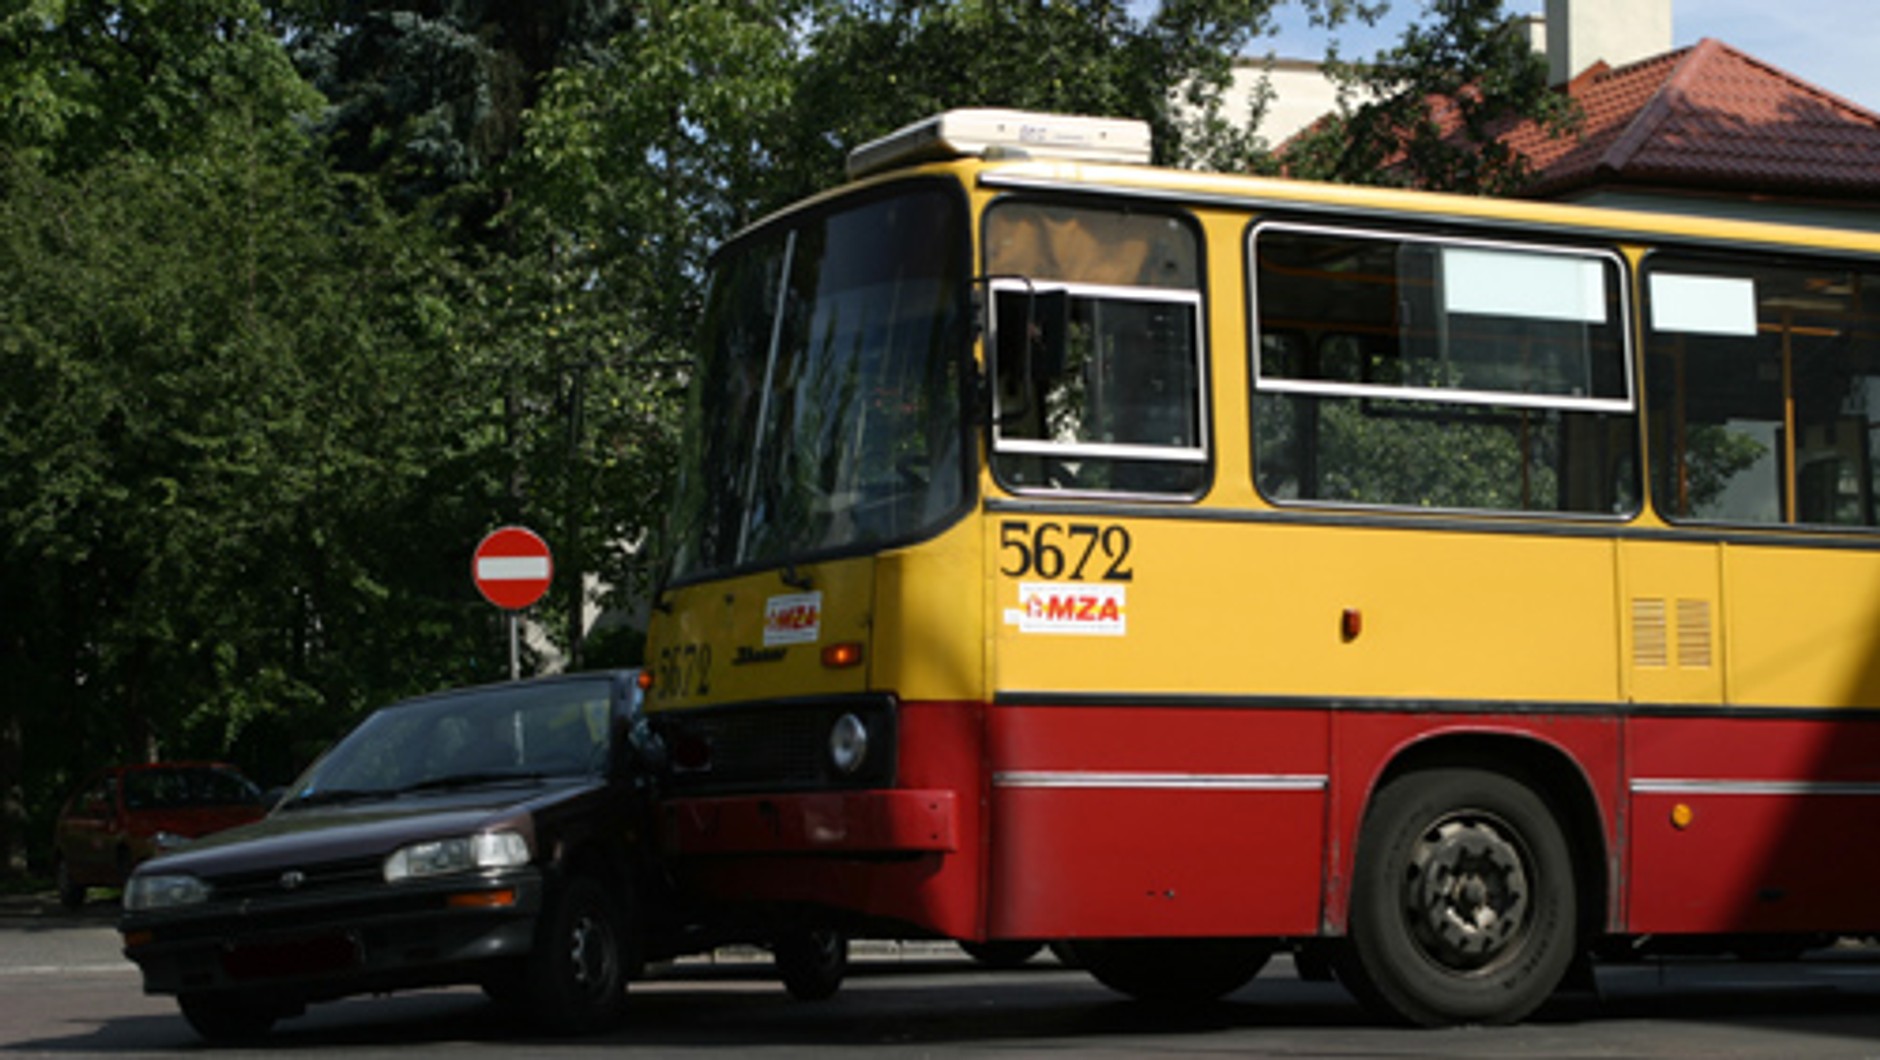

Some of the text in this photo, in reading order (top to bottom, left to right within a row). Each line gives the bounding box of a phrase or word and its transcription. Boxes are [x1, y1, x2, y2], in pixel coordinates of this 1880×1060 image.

[1000, 521, 1133, 582] 5672
[775, 605, 817, 630] MZA
[1047, 595, 1119, 621] MZA
[657, 643, 712, 699] 5672
